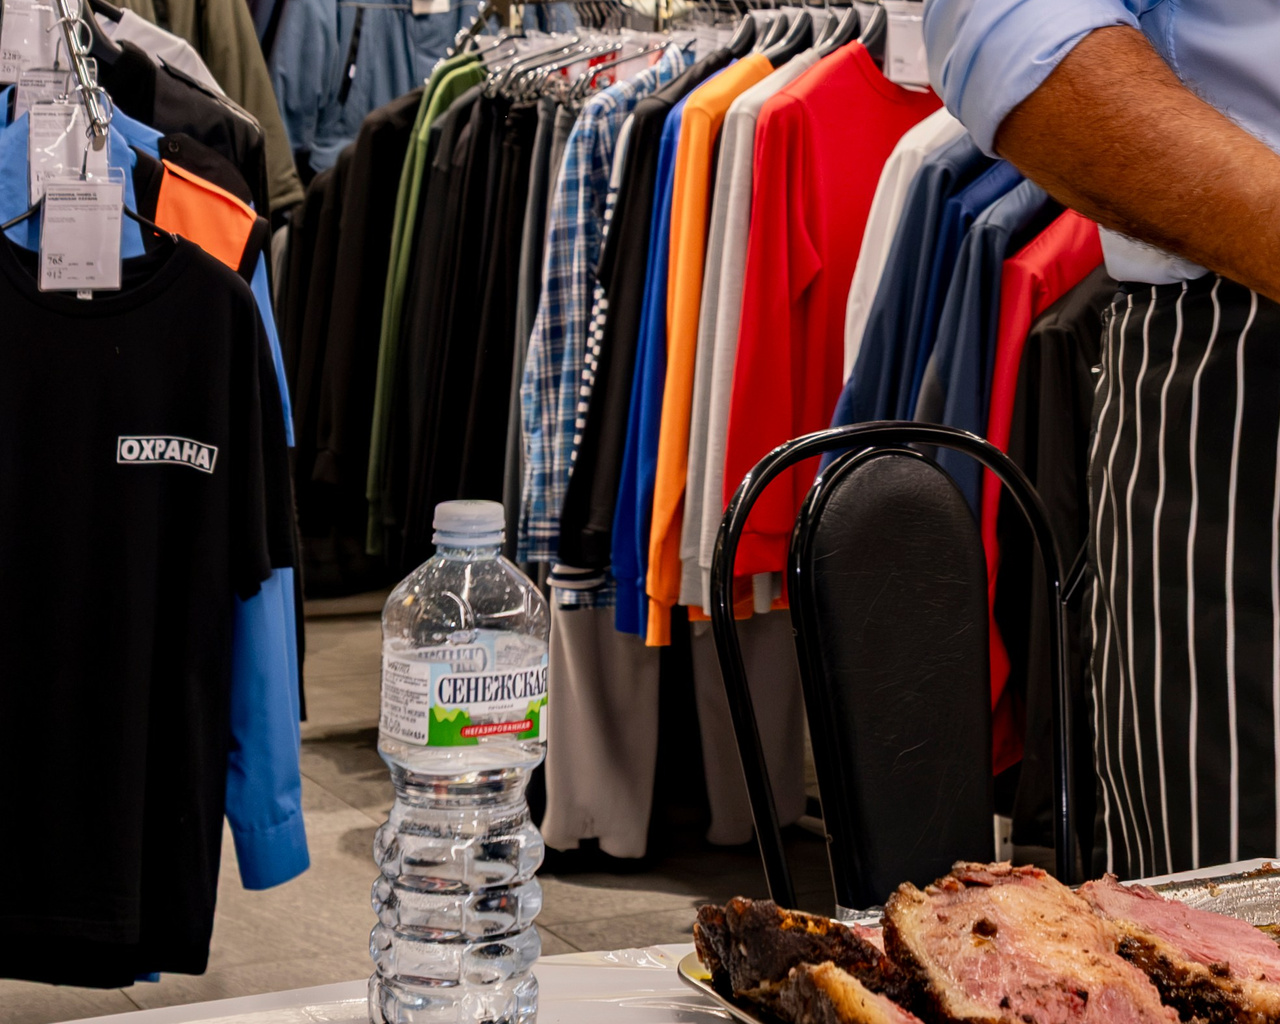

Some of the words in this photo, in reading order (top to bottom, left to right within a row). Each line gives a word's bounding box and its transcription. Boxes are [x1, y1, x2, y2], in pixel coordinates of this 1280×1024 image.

[120, 439, 210, 469] ОХРАНА
[438, 666, 547, 705] СЕНЕЖСКАЯ
[464, 721, 531, 736] НЕГАЗИРОВАННАЯ
